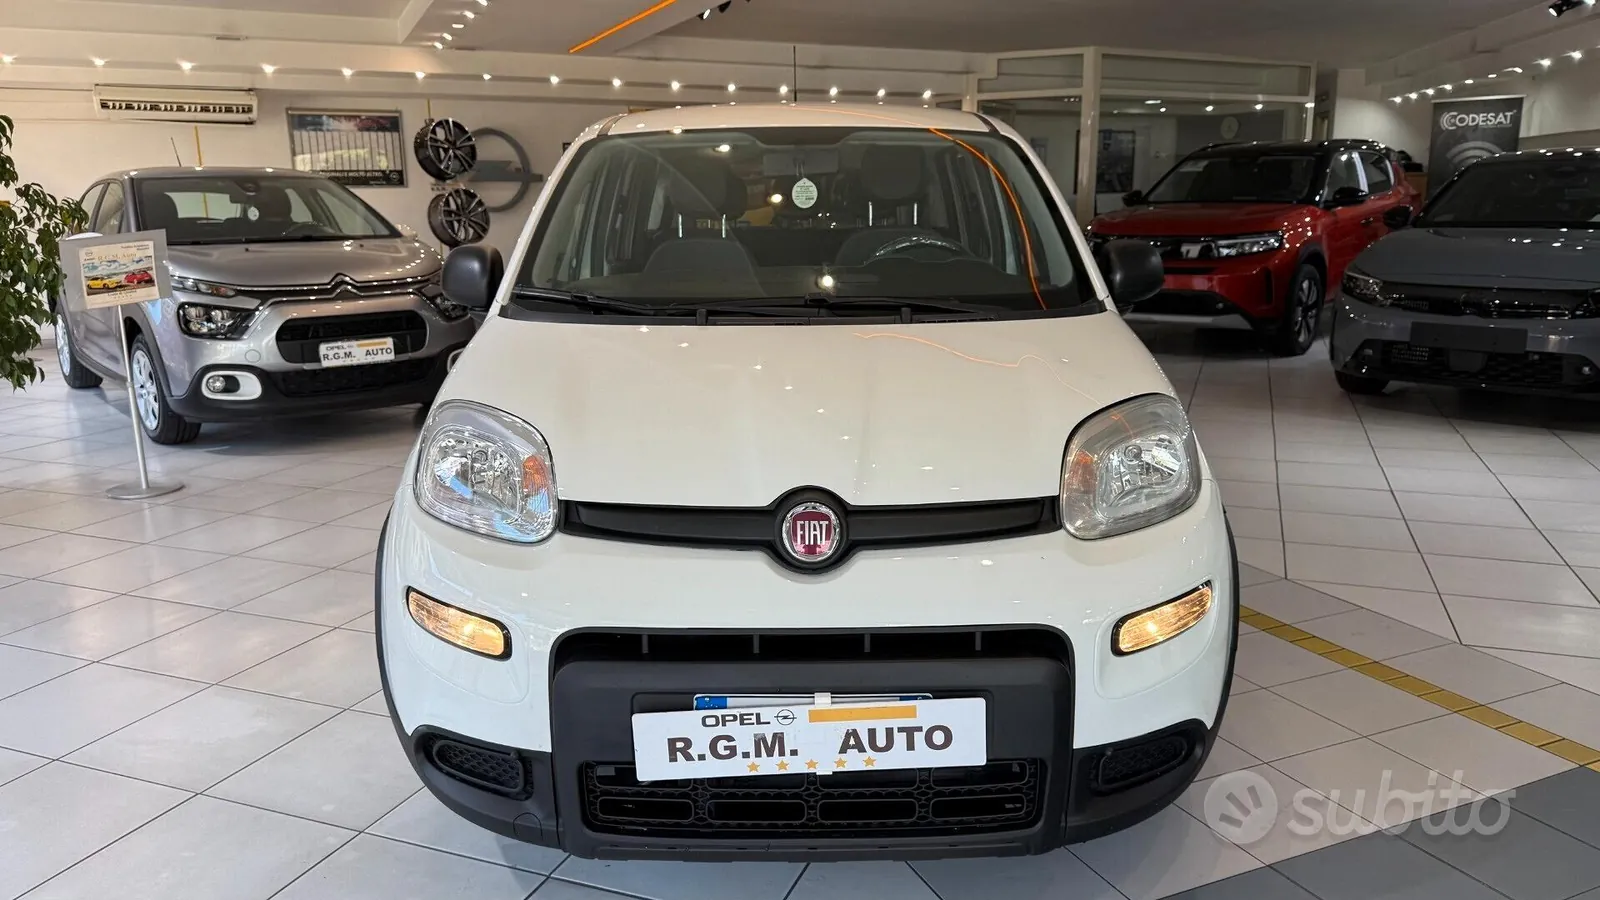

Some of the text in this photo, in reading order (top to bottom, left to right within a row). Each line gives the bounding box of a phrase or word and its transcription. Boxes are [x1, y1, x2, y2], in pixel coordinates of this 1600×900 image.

[1441, 111, 1514, 130] CODESAT
[322, 347, 393, 361] R.G.M. AUTO
[796, 520, 829, 546] FIAT
[701, 711, 771, 728] OPEL
[667, 724, 954, 763] R.G.M. AUTO
